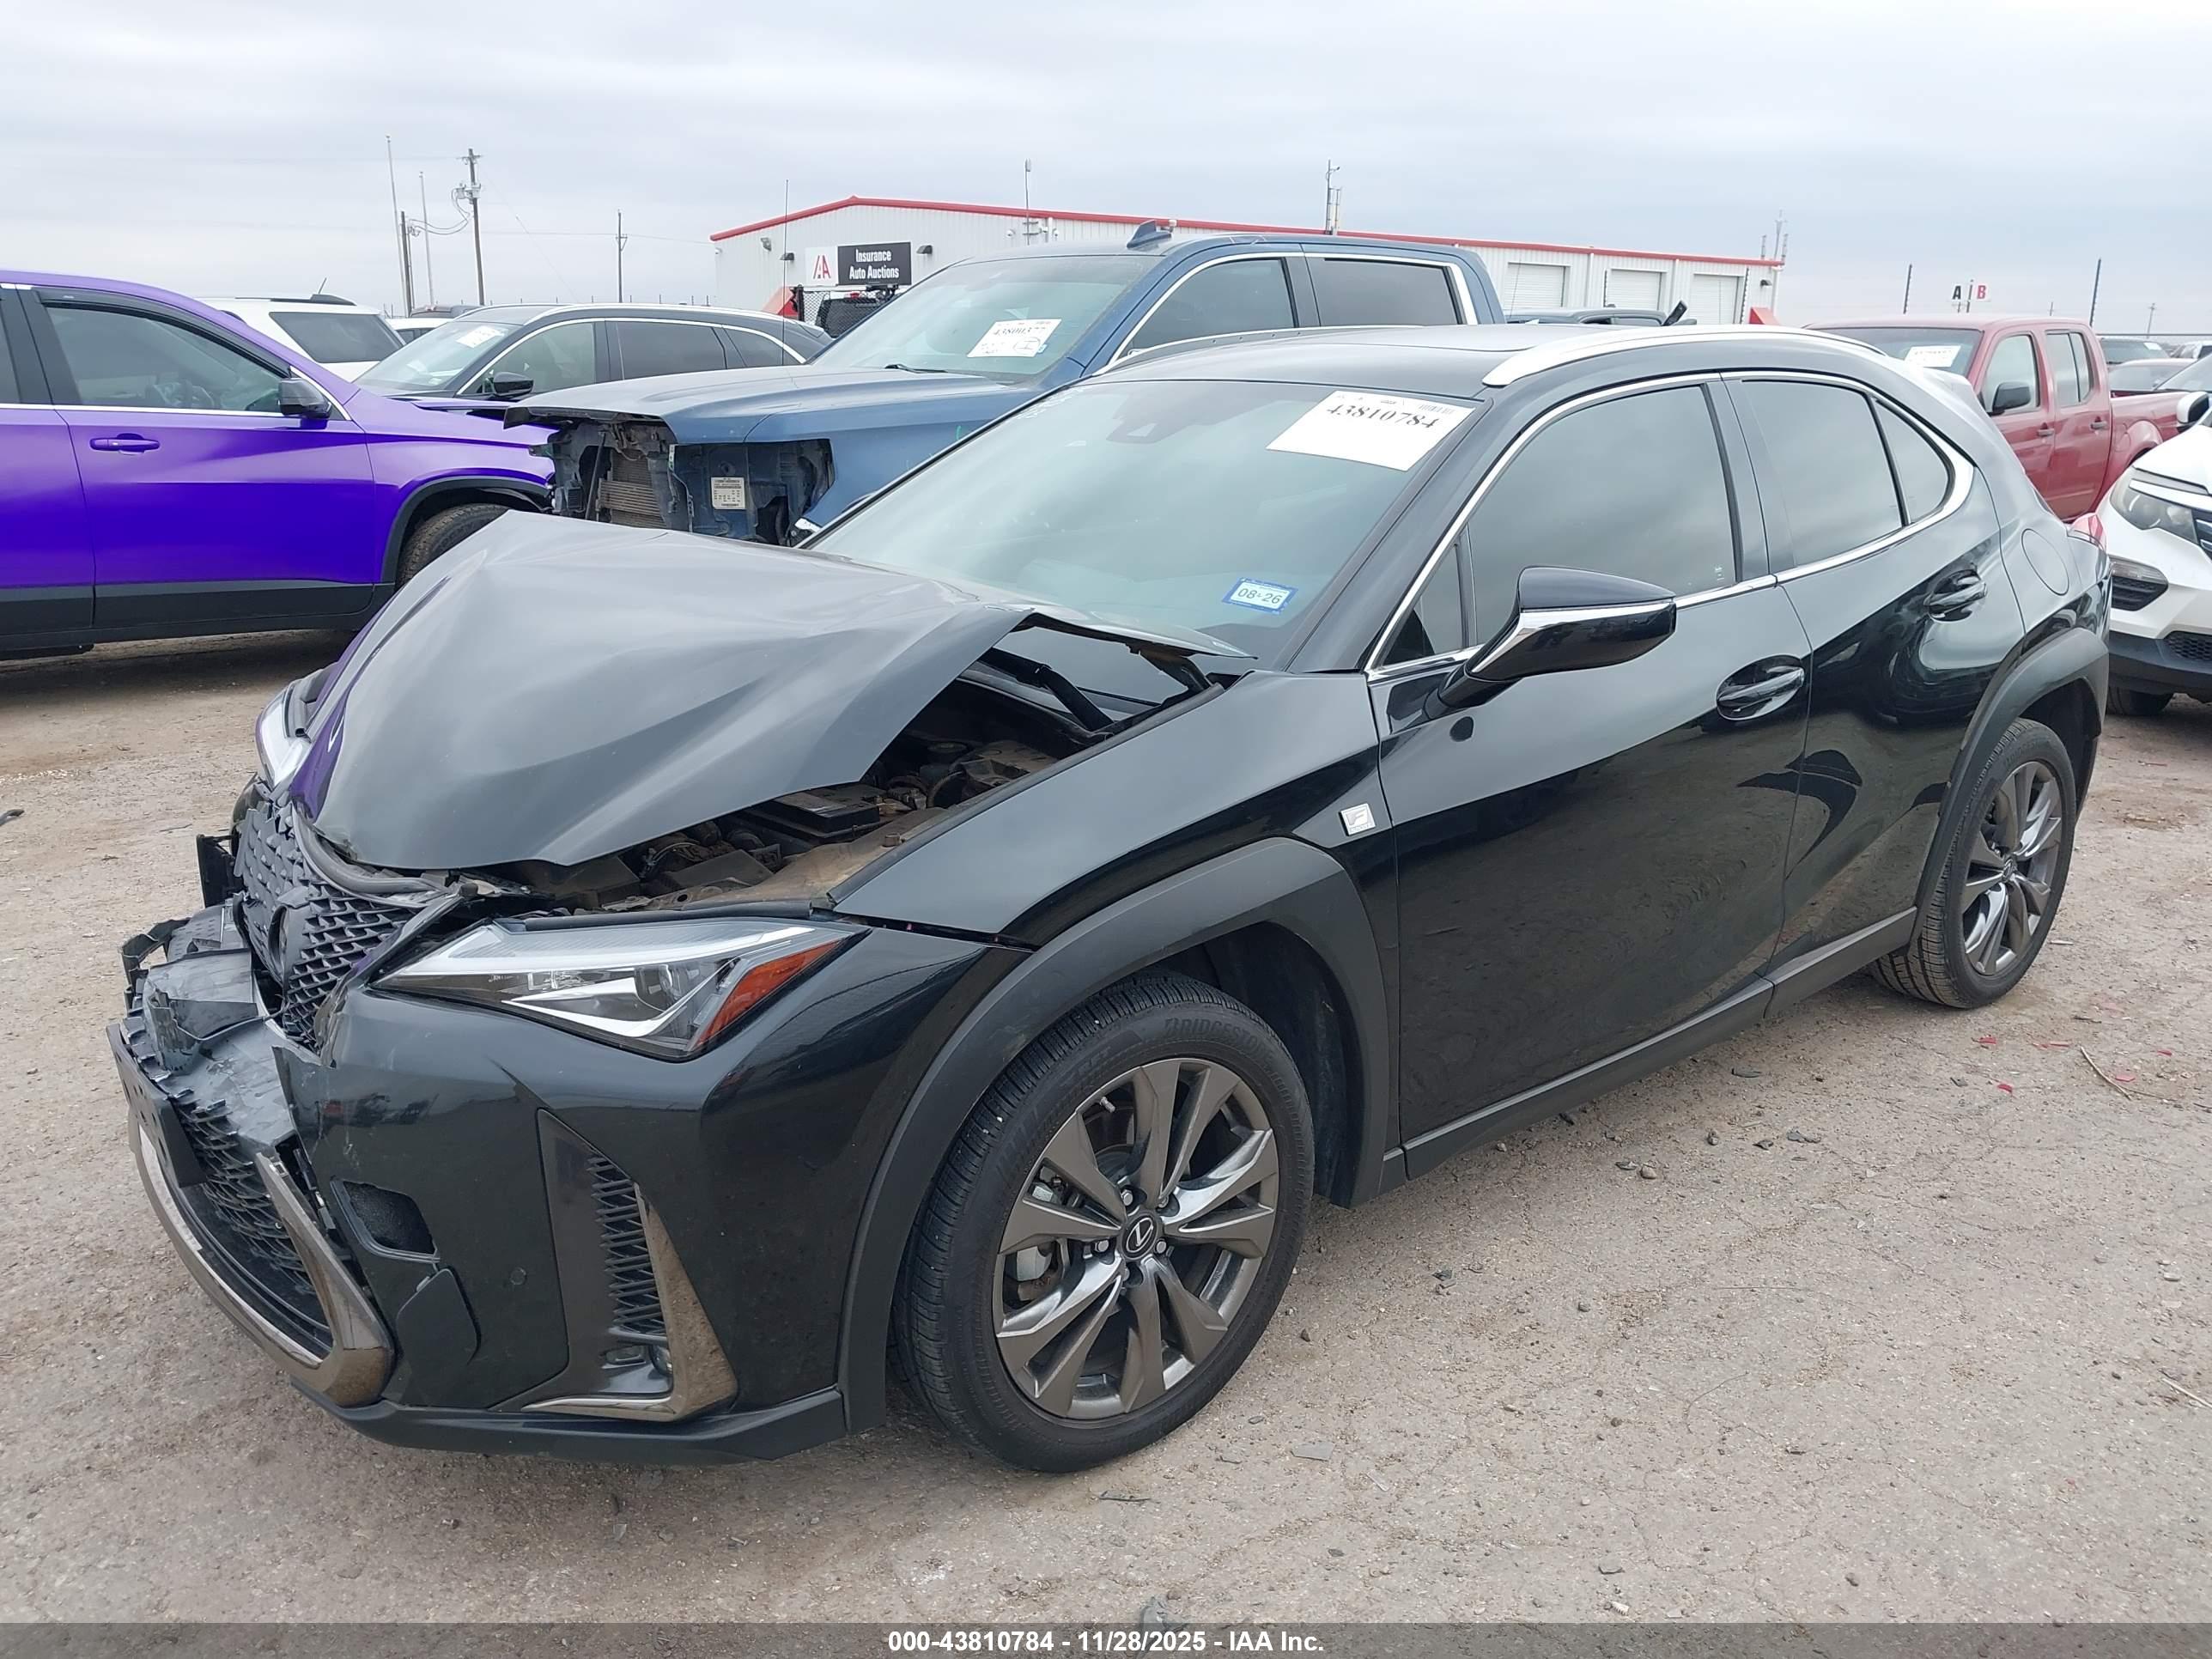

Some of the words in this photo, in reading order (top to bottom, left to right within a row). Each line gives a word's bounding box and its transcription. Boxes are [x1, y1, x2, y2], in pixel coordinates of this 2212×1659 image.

[855, 249, 892, 263] Insurance
[848, 266, 866, 280] Auto
[866, 264, 900, 279] Auctions
[1952, 285, 1961, 300] A
[1977, 285, 1987, 299] B
[1327, 404, 1439, 429] 43810784
